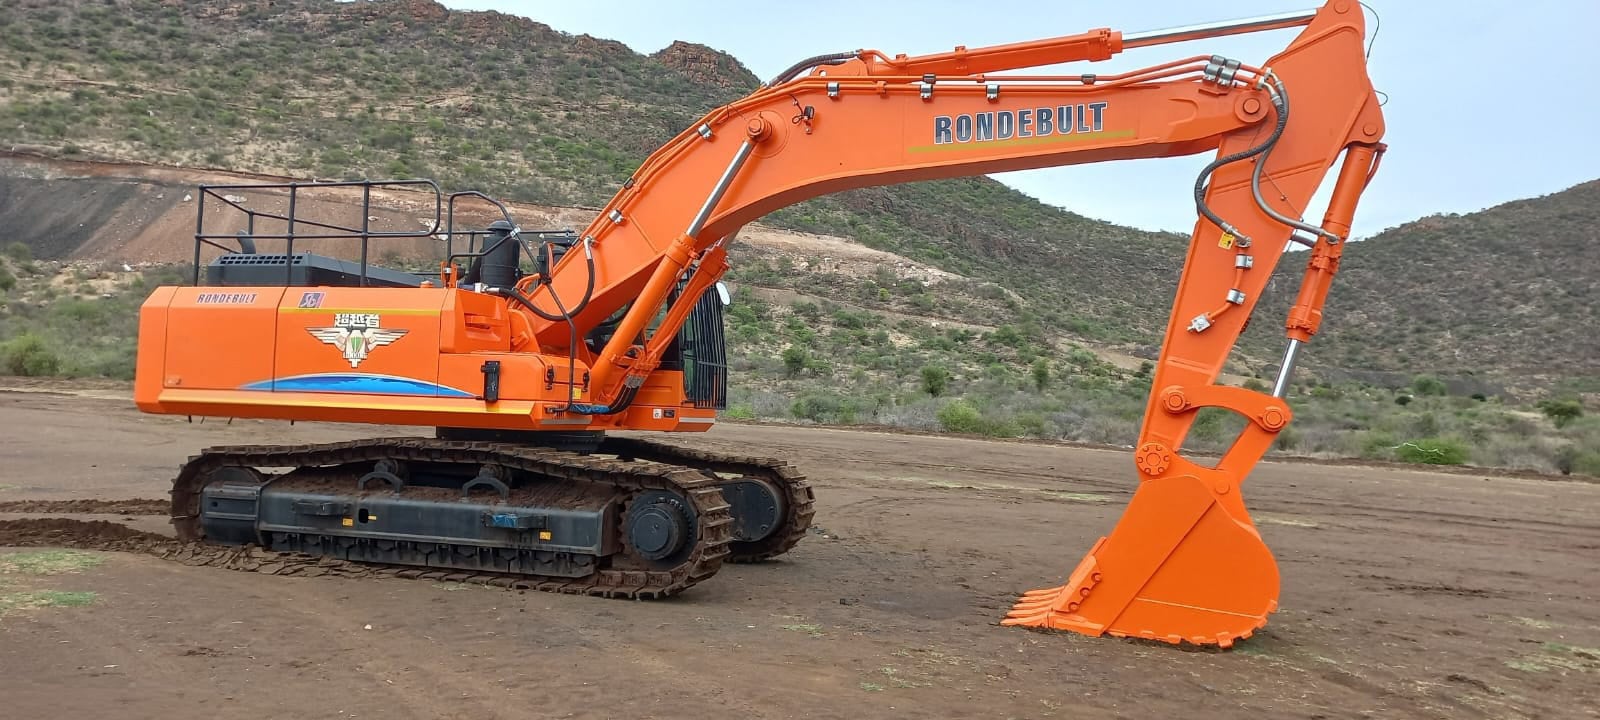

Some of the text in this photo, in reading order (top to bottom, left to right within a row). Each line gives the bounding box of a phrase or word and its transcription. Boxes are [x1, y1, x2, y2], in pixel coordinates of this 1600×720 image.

[934, 101, 1108, 144] RONDEBULT
[197, 292, 257, 303] RONDEBULT
[334, 313, 380, 328] 超越者
